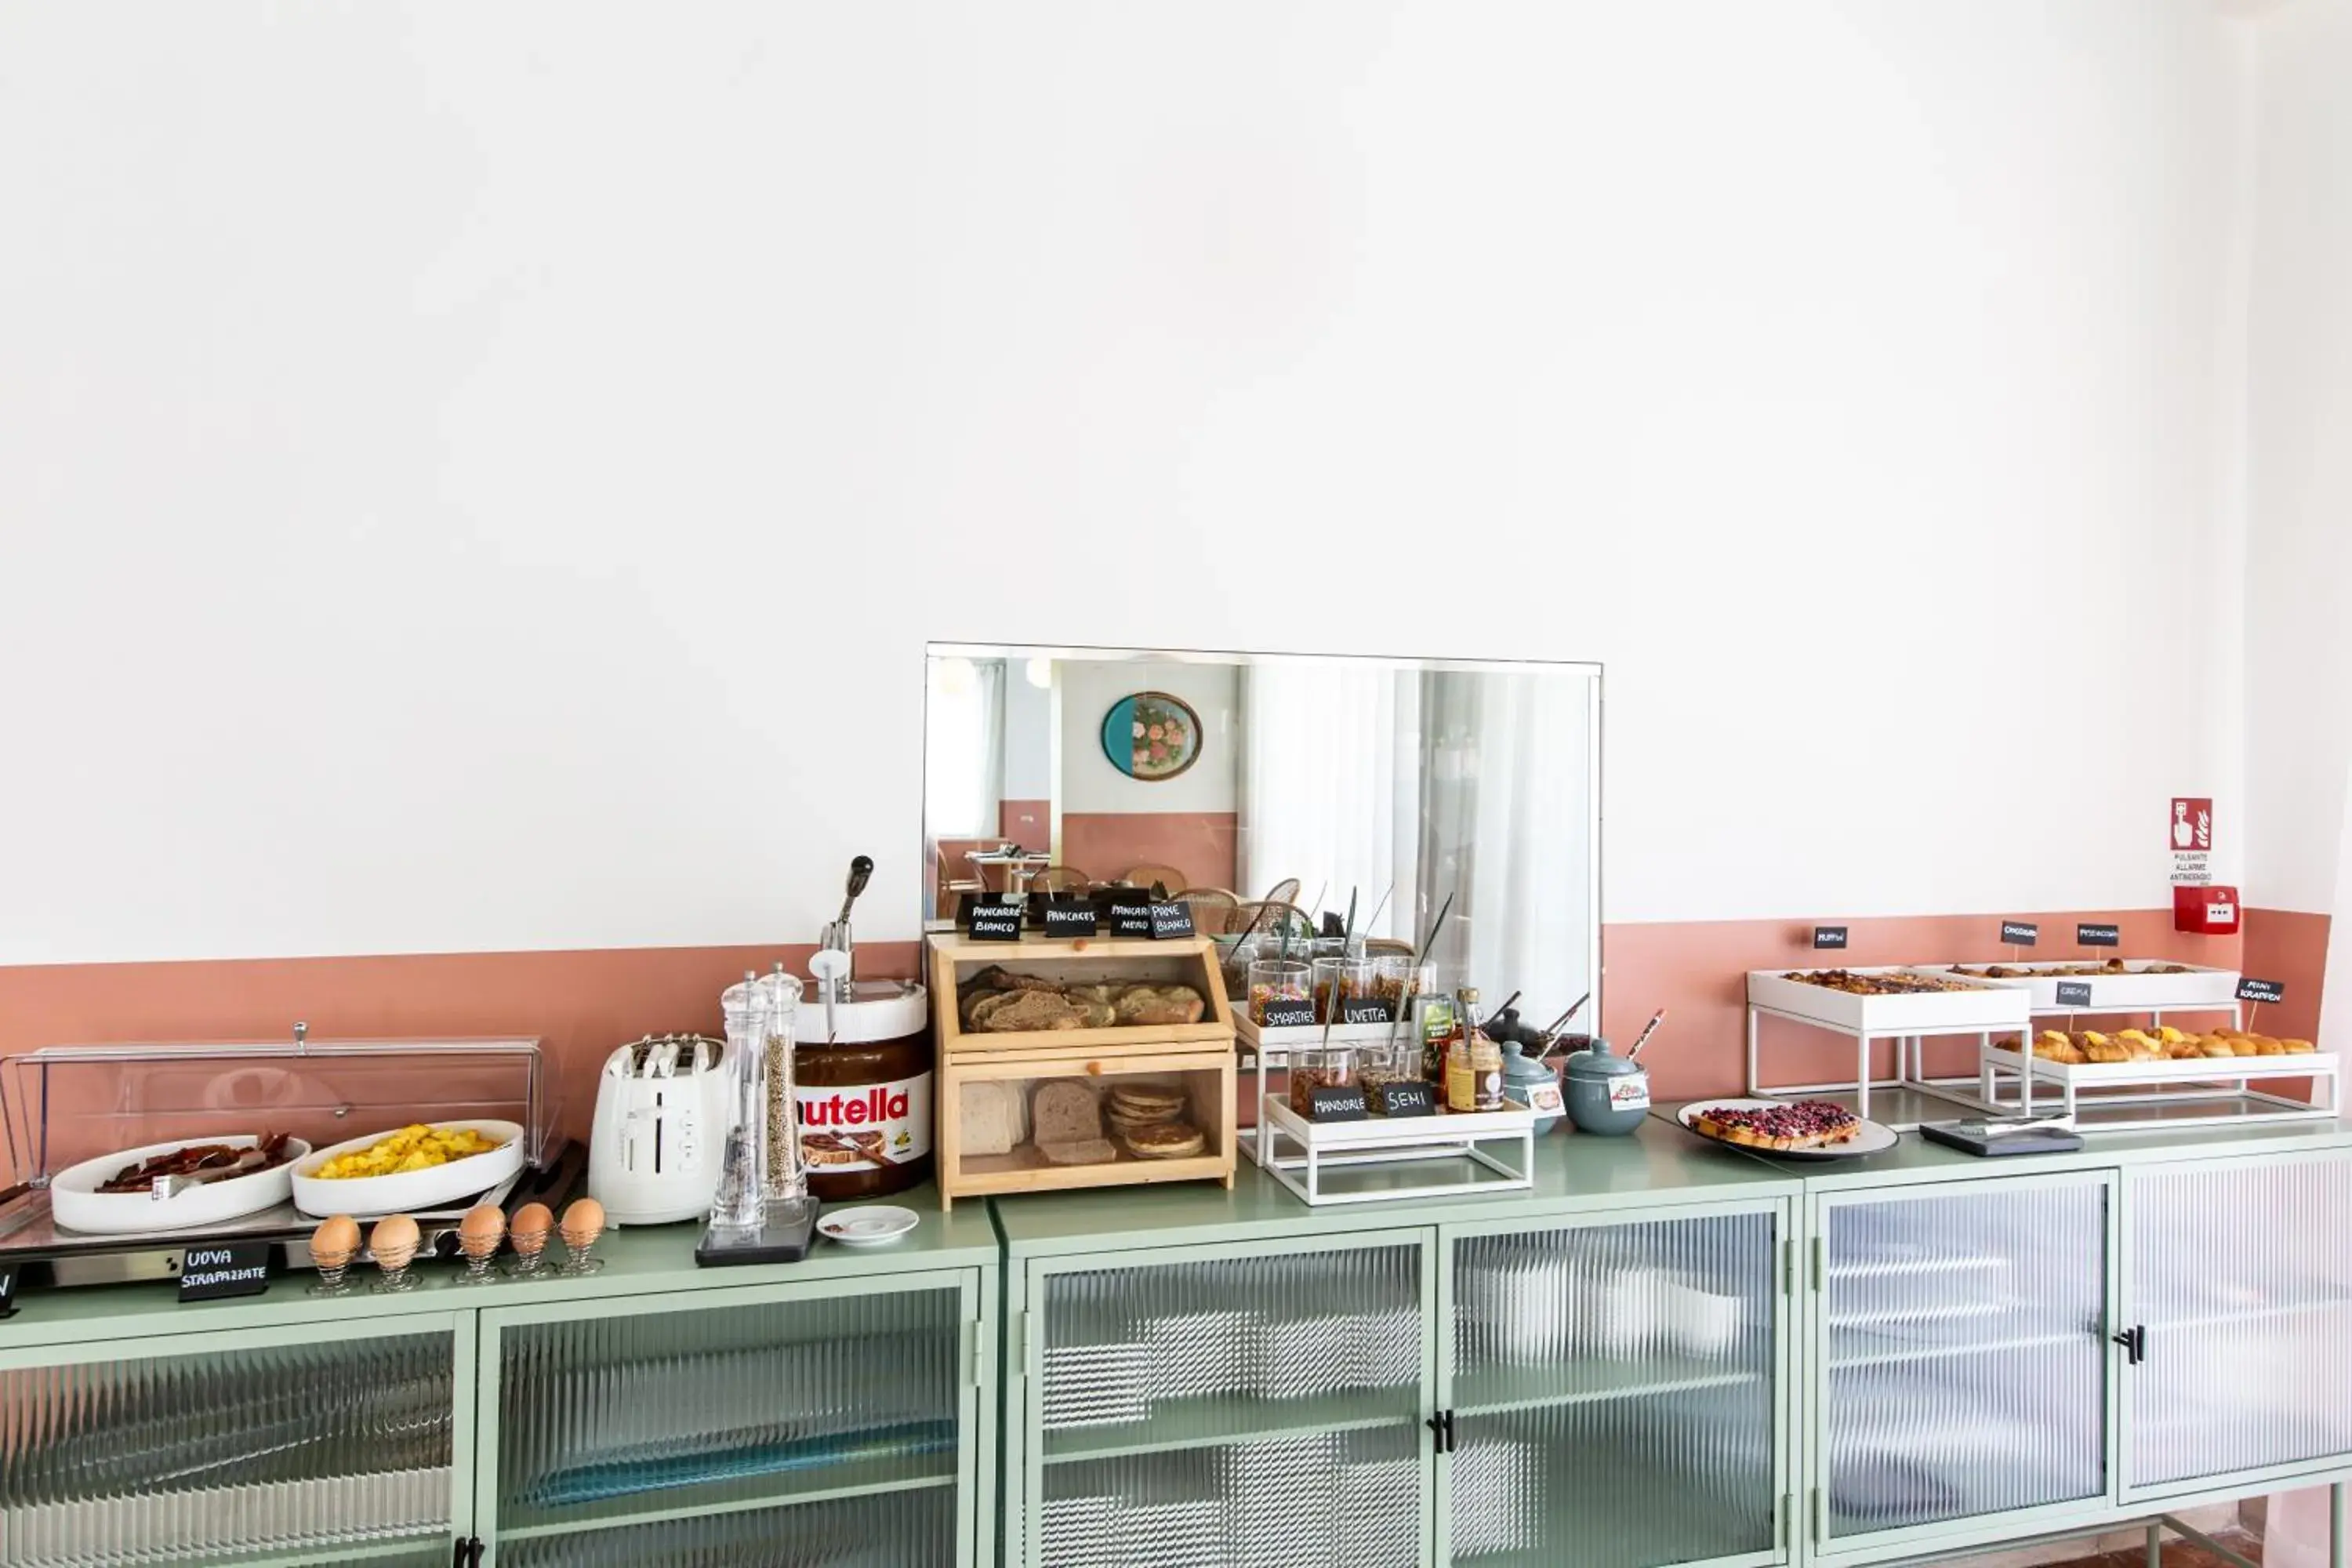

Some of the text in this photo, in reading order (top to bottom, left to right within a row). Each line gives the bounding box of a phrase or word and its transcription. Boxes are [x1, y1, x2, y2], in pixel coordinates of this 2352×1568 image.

[1047, 910, 1095, 922] PANCAKES
[1111, 905, 1150, 916] PANCAR
[1152, 904, 1180, 917] PANE
[975, 921, 1015, 933] BIANCO
[1120, 920, 1149, 929] NERO
[1156, 918, 1191, 931] BIANCO
[1266, 1011, 1315, 1026] SMARTIES
[1345, 1007, 1387, 1023] UVETTA
[1315, 1098, 1365, 1113] MANDORLE
[1388, 1091, 1426, 1111] SEMI
[187, 1250, 231, 1266] UOVA
[181, 1267, 266, 1288] STRAPAZZATE
